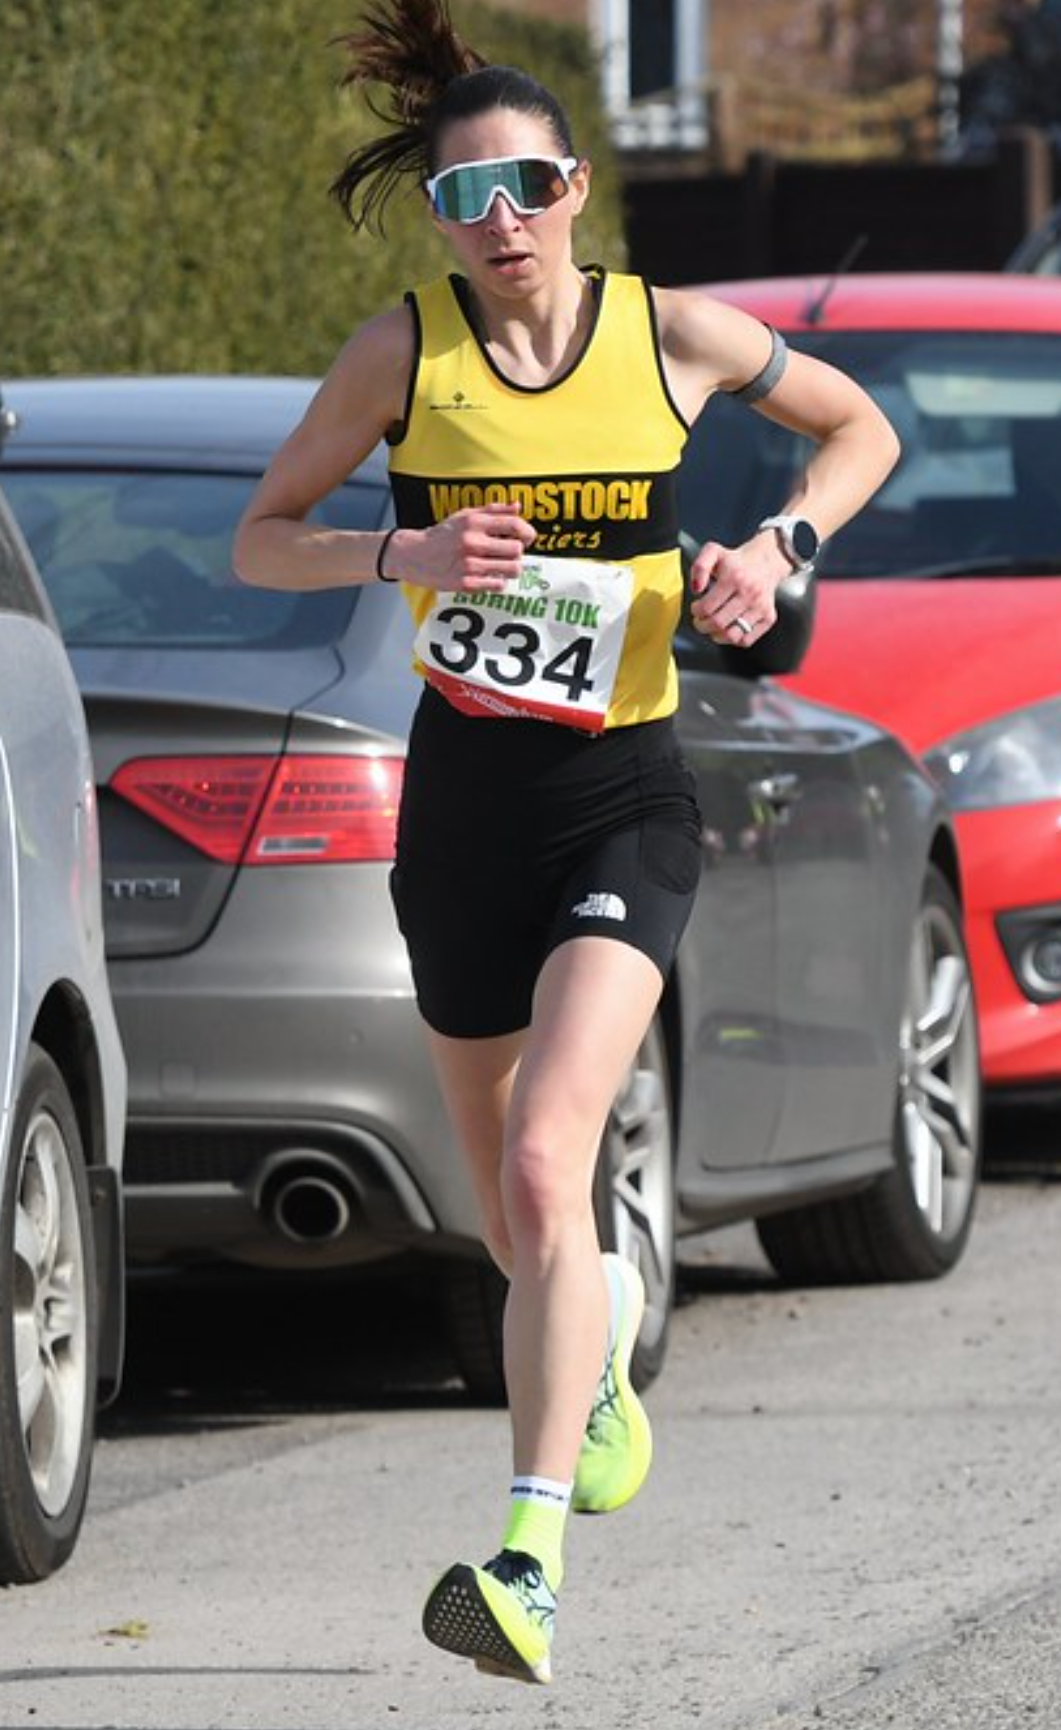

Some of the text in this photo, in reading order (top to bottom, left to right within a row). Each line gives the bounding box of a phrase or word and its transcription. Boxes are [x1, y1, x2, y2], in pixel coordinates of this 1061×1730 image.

[429, 479, 652, 523] WOODSTOCK
[534, 523, 603, 551] riers
[553, 598, 601, 629] 10K
[429, 607, 594, 702] 334
